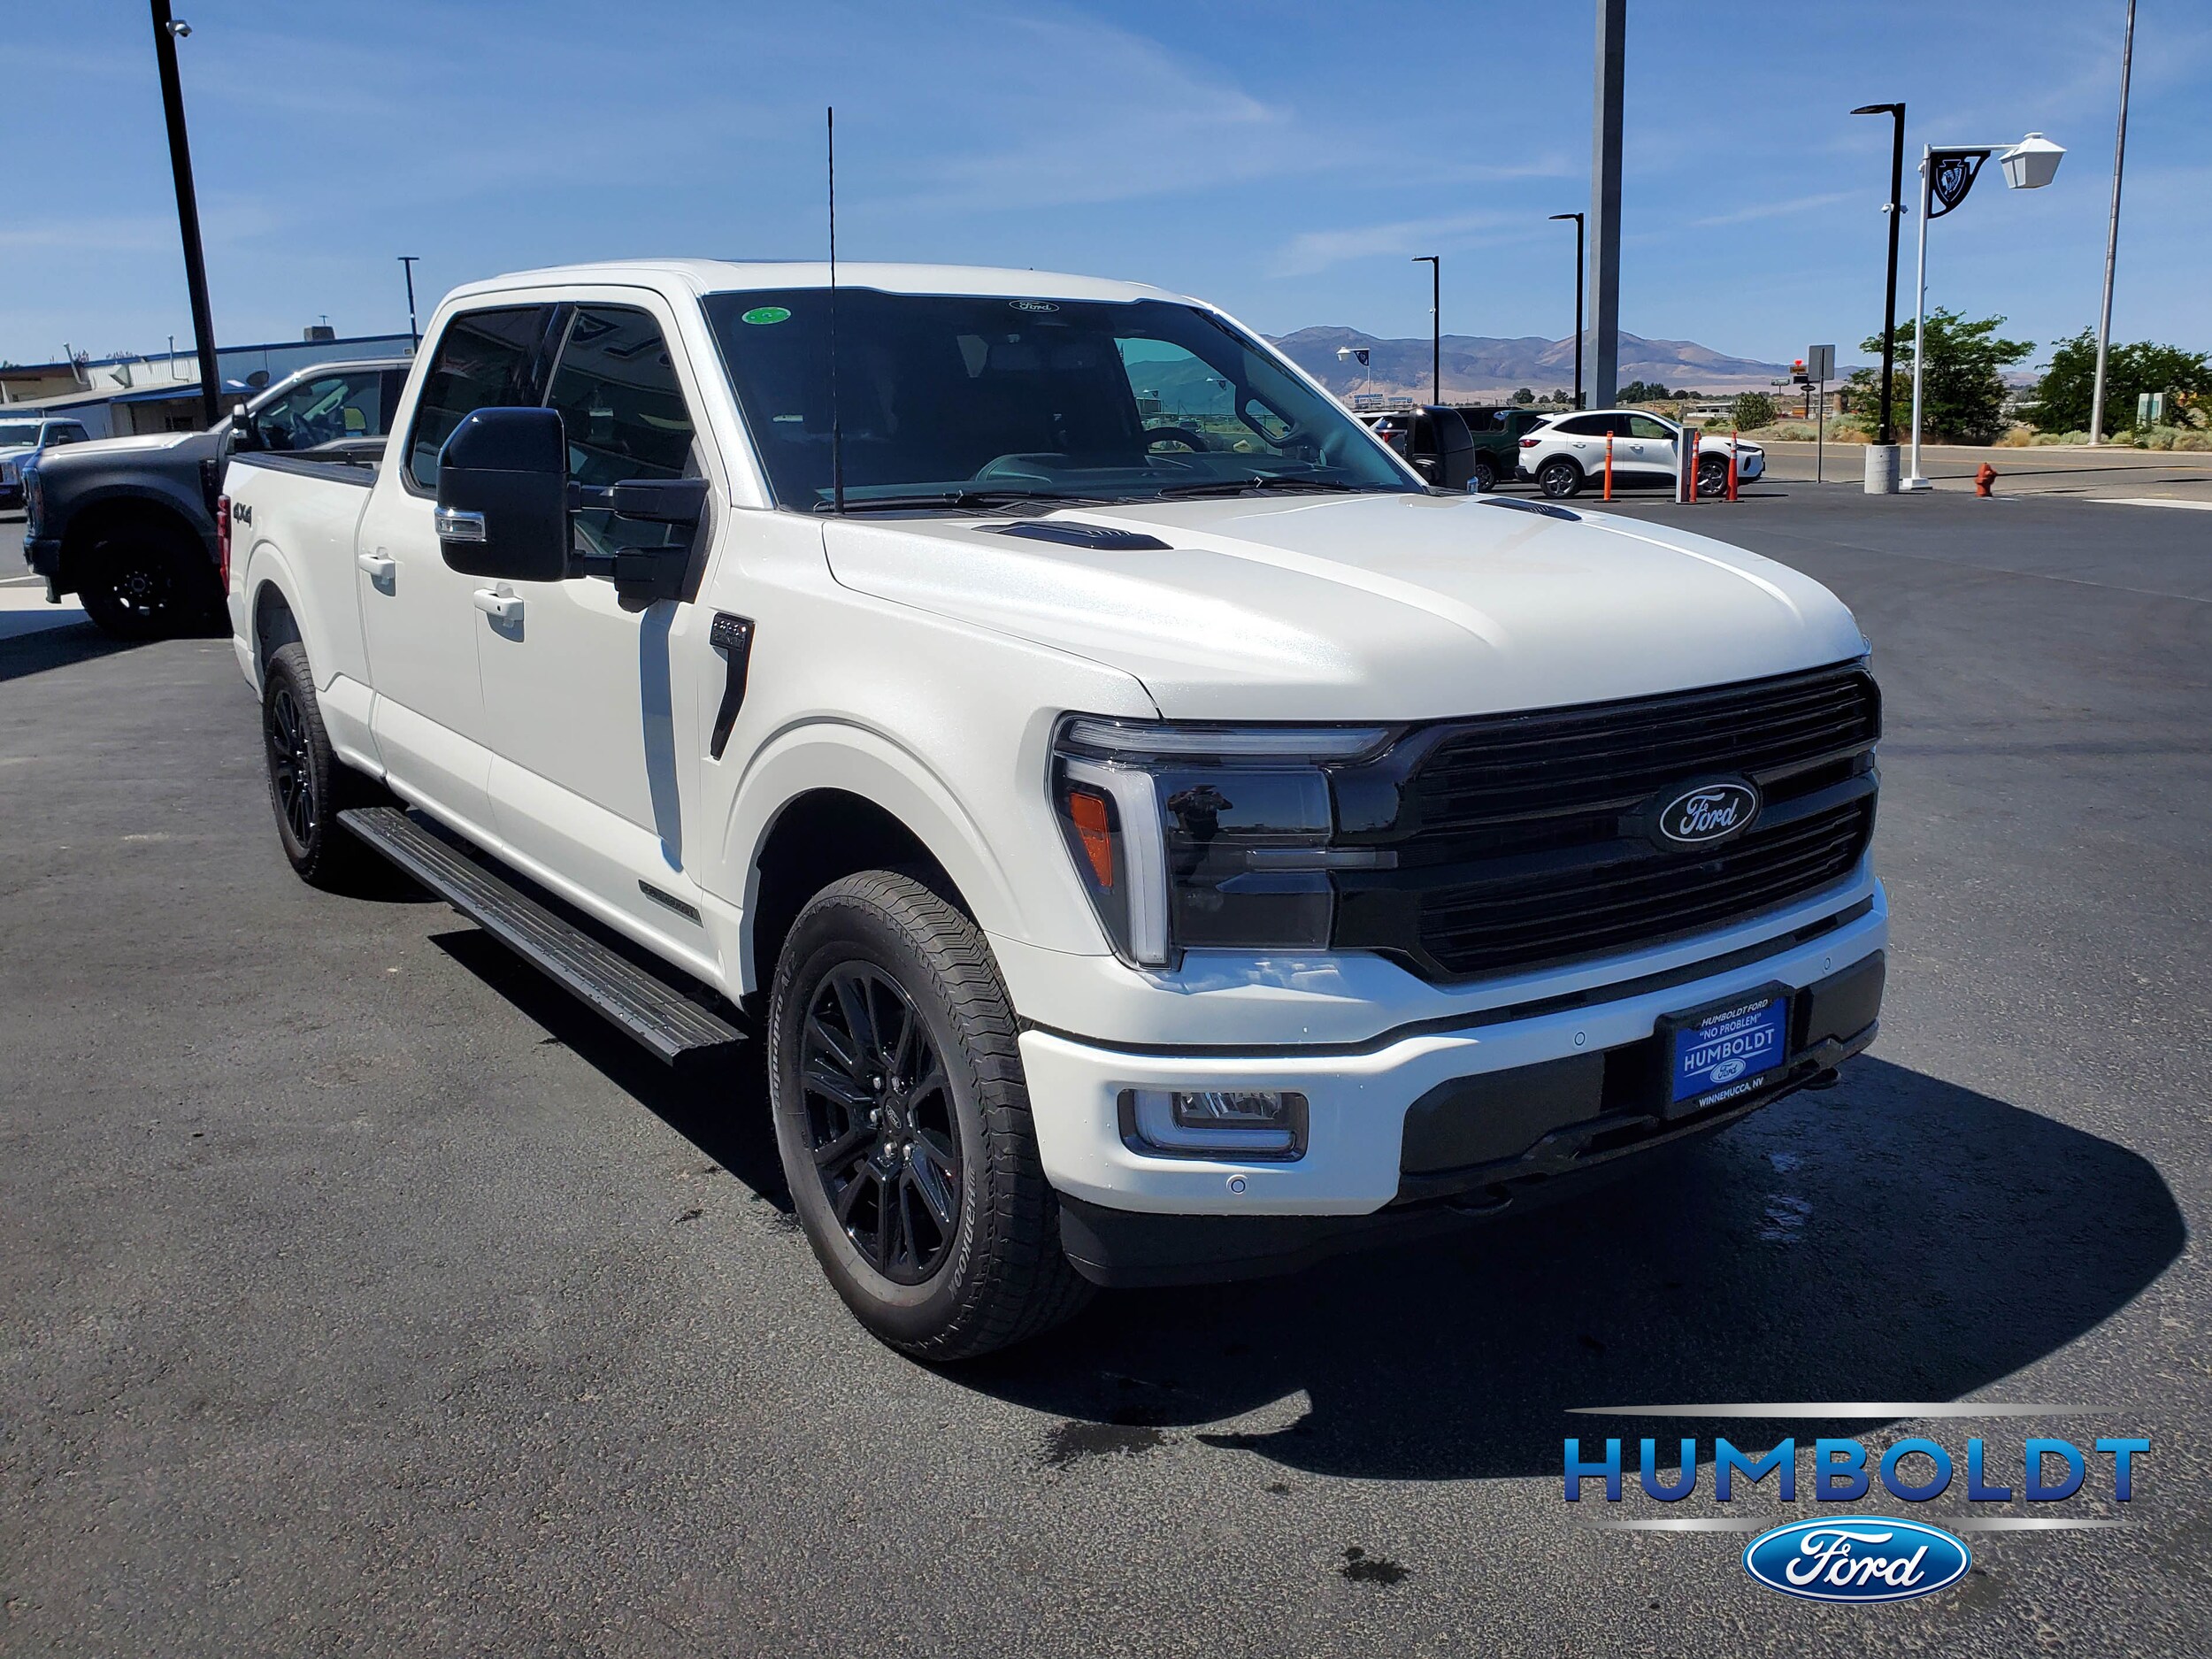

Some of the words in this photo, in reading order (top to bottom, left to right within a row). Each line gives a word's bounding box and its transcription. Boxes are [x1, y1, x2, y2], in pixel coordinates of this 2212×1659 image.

[1680, 793, 1739, 834] Ford
[1701, 1006, 1748, 1027] HUMBOLDT
[1747, 999, 1768, 1013] FORD
[1685, 1028, 1775, 1071] HUMBOLDT
[1717, 1063, 1739, 1079] Ford
[1699, 1083, 1751, 1108] WINNEMUCCA,
[1752, 1077, 1764, 1089] NV
